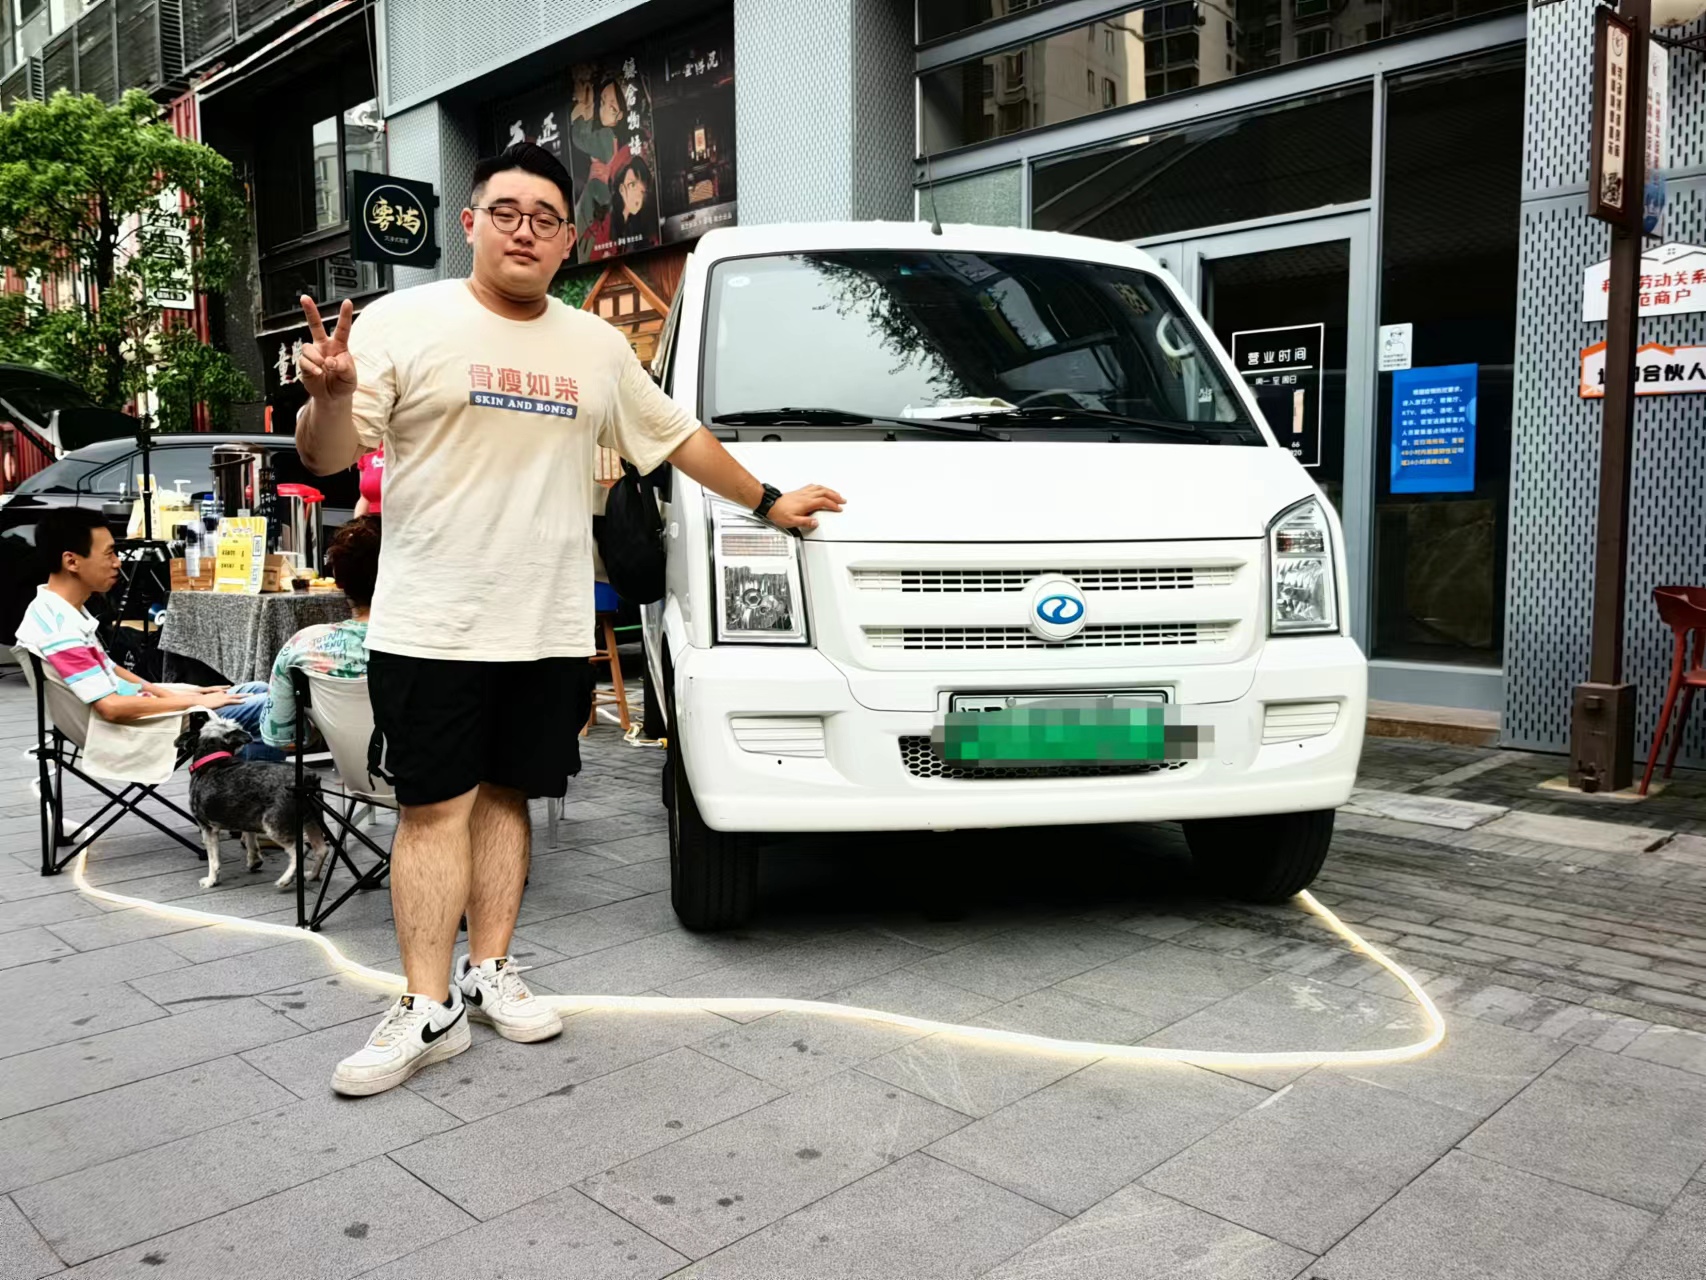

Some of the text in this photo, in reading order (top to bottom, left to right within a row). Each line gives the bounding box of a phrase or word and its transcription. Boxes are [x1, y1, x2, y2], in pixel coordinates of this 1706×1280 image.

[1248, 347, 1307, 365] 营业时间
[468, 364, 579, 403] 骨瘦如柴
[474, 394, 573, 416] SKIN AND BONES
